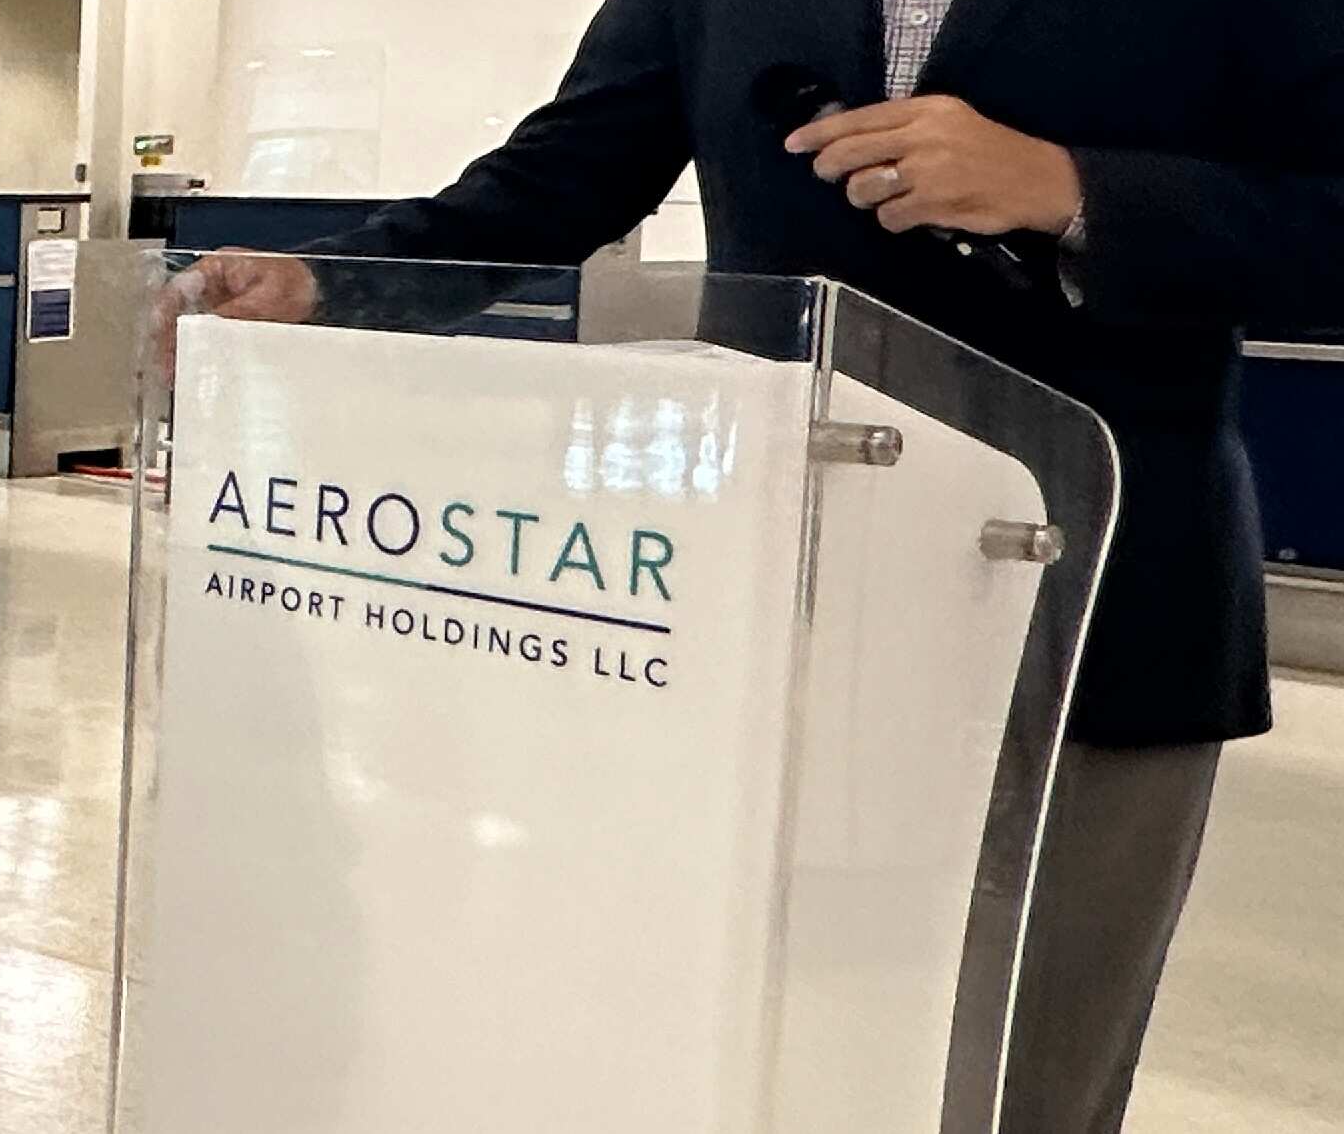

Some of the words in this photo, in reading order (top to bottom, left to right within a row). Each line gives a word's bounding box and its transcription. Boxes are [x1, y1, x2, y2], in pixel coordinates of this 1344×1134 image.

[208, 470, 675, 601] AEROSTAR
[204, 571, 346, 620] AIRPORT
[365, 601, 569, 668] HOLDINGS
[593, 646, 669, 689] LLC
